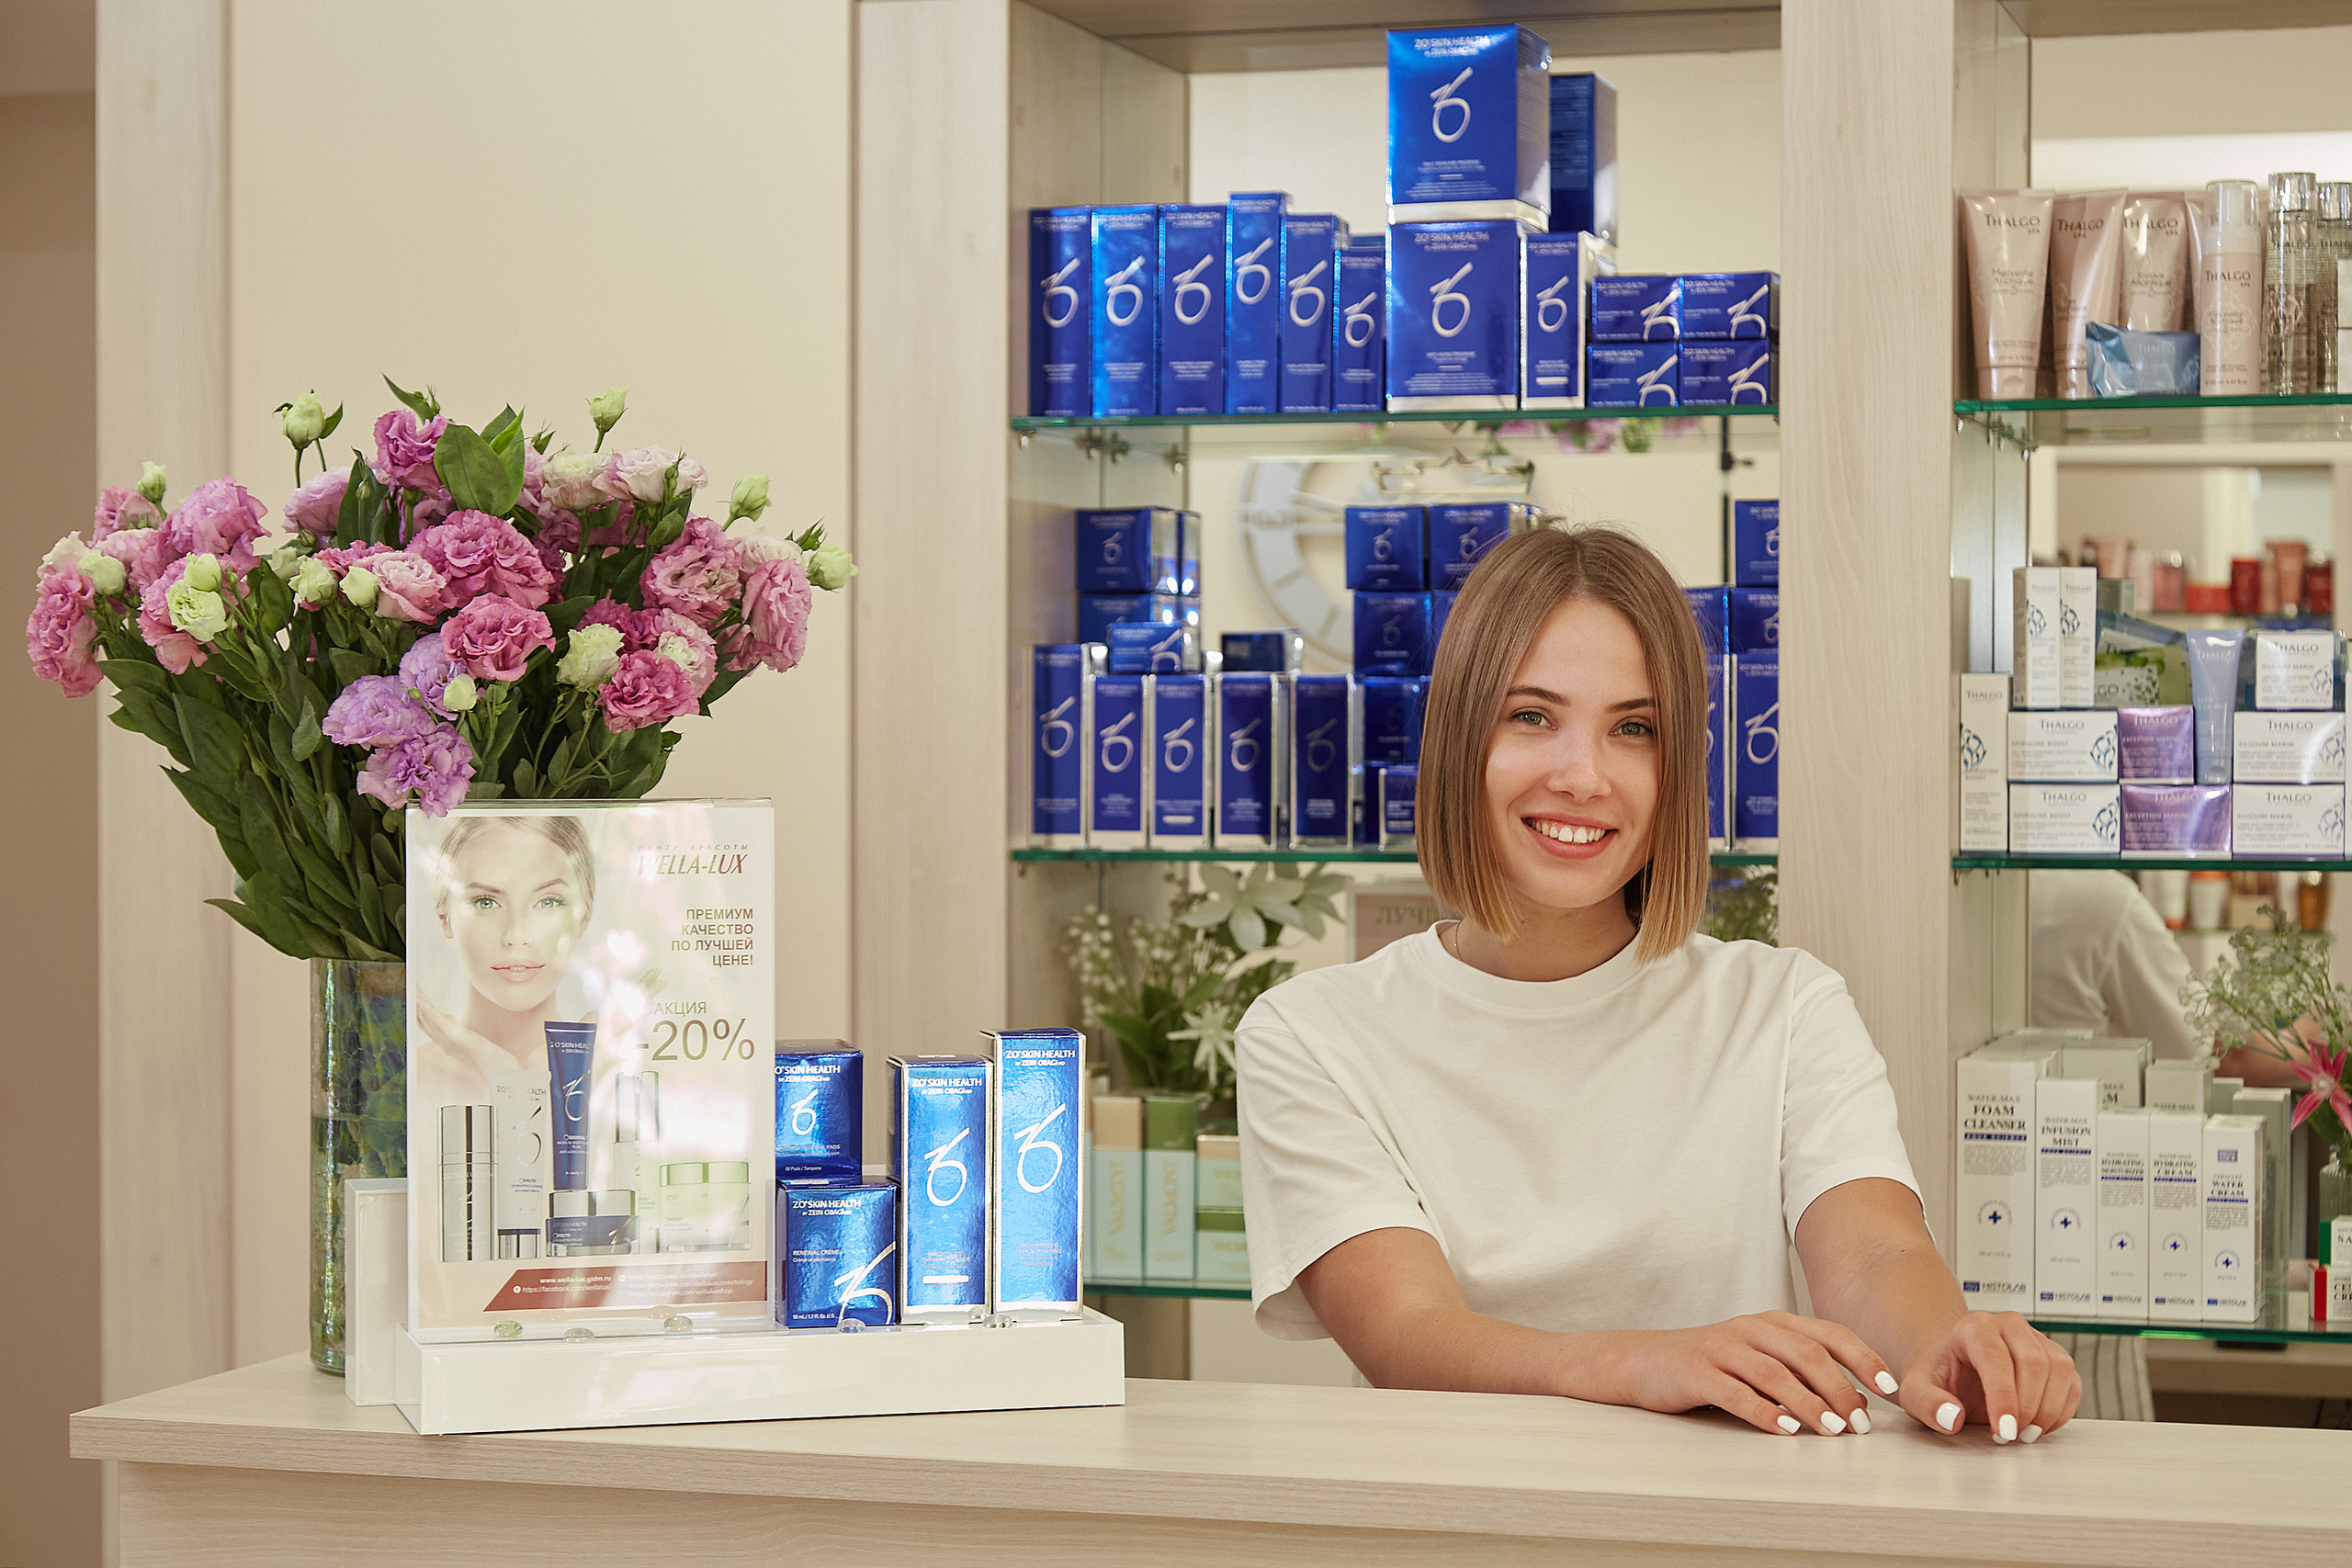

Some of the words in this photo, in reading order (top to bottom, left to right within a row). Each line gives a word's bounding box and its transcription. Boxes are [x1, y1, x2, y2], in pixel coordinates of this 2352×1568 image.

[1984, 213, 2041, 227] THALGO
[2057, 218, 2104, 231] THALGO
[2207, 270, 2251, 281] THALGO
[2275, 642, 2319, 652] THALGO
[1967, 691, 2003, 699] THALGO
[2041, 719, 2085, 729] THALGO
[2134, 716, 2178, 727] THALGO
[2268, 720, 2313, 730] THALGO
[2043, 791, 2087, 802] THALGO
[2267, 792, 2312, 803] THALGO
[686, 908, 753, 920] ПРЕМИУМ
[682, 924, 753, 936] КАЧЕСТВО
[672, 940, 691, 952] ПО
[694, 938, 753, 951] ЛУЧШЕЙ
[712, 954, 753, 967] ЦЕНЕ!
[654, 1002, 707, 1016] АКЦИЯ
[636, 1018, 754, 1062] -20%
[1021, 1050, 1041, 1058] SKIN
[1042, 1050, 1076, 1058] HEALTH
[785, 1066, 805, 1074] SKIN
[927, 1078, 948, 1087] SKIN
[948, 1077, 982, 1087] HEALTH
[1973, 1105, 2015, 1115] FOAM
[1964, 1119, 2026, 1130] CLEANSER
[2041, 1126, 2091, 1135] INFUSION
[2052, 1138, 2079, 1146] MIST
[828, 1200, 862, 1208] HEALTH
